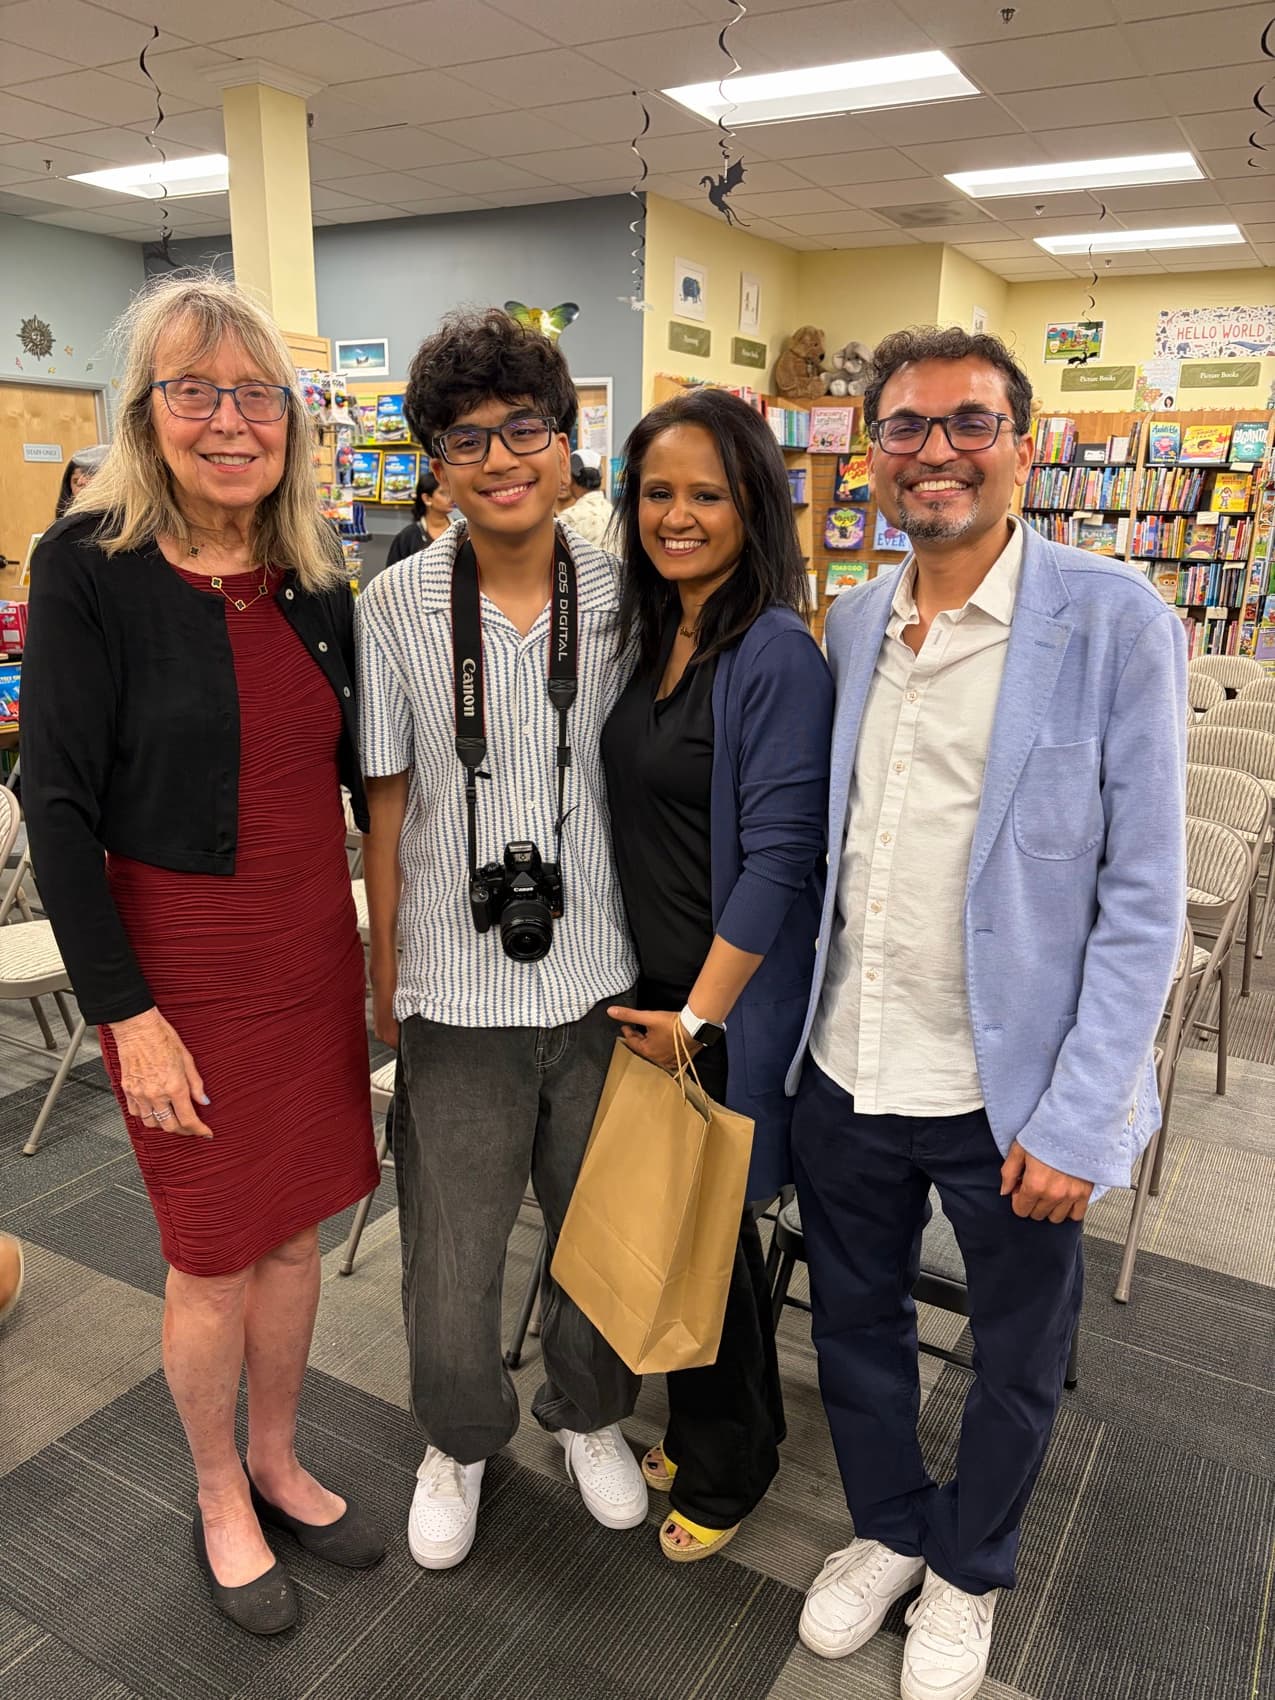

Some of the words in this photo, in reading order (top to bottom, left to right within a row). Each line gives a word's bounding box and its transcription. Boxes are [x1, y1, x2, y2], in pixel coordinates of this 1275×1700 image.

[1177, 326, 1217, 340] HELLO
[1222, 323, 1265, 338] WORLD
[1200, 372, 1219, 380] Picture
[1220, 371, 1239, 379] Books
[558, 561, 568, 594] EOS
[558, 599, 569, 662] DIGITAL
[462, 658, 476, 717] Canon
